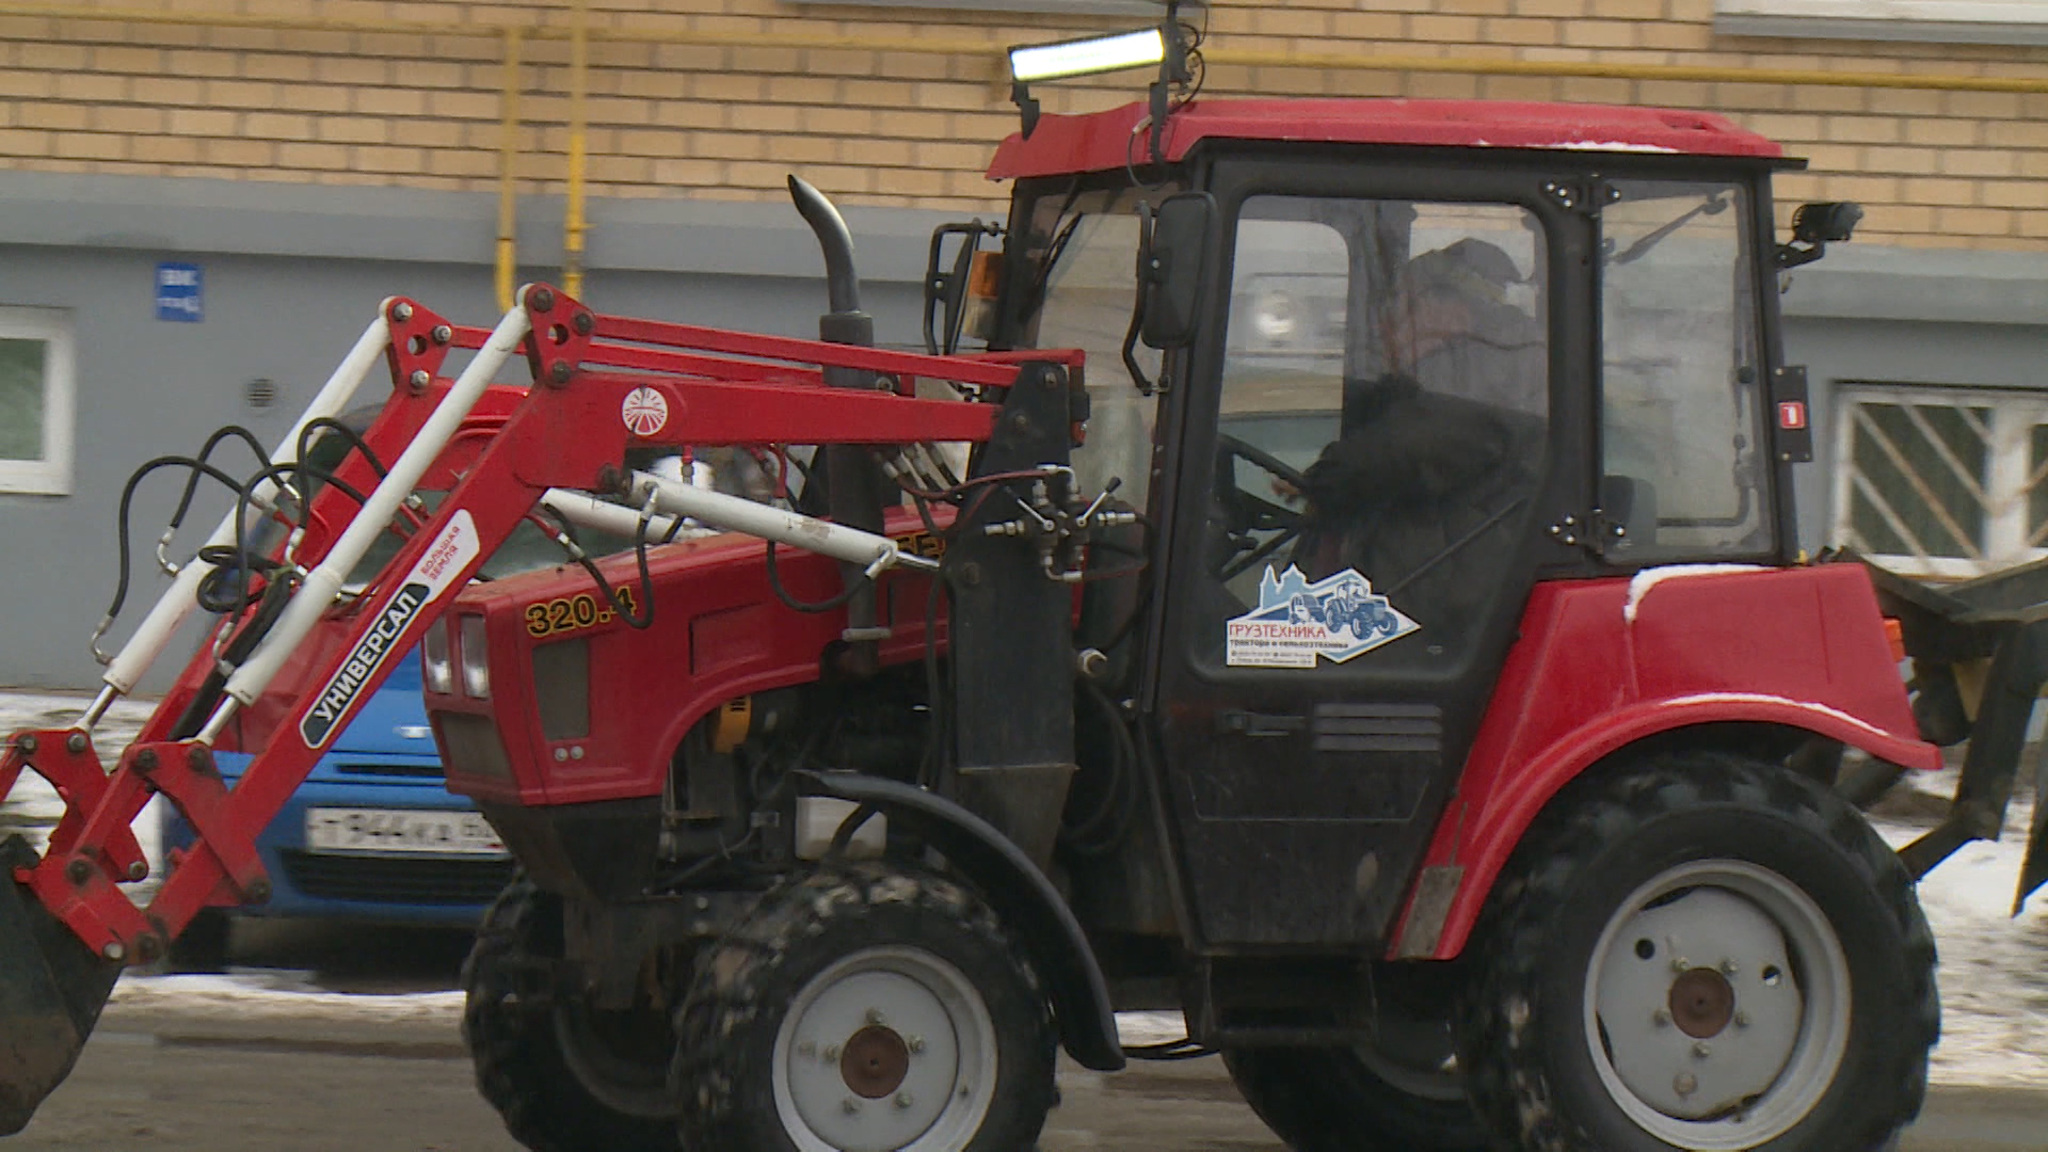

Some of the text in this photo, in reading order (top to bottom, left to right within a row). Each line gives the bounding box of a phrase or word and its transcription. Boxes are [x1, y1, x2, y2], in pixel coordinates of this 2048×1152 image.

[420, 526, 460, 574] БОЛЬШАЯ
[429, 545, 459, 580] ЗЕМЛЯ
[1229, 624, 1328, 639] ГРУЗТЕХНИКА
[314, 590, 419, 721] УНИВЕРСАЛ
